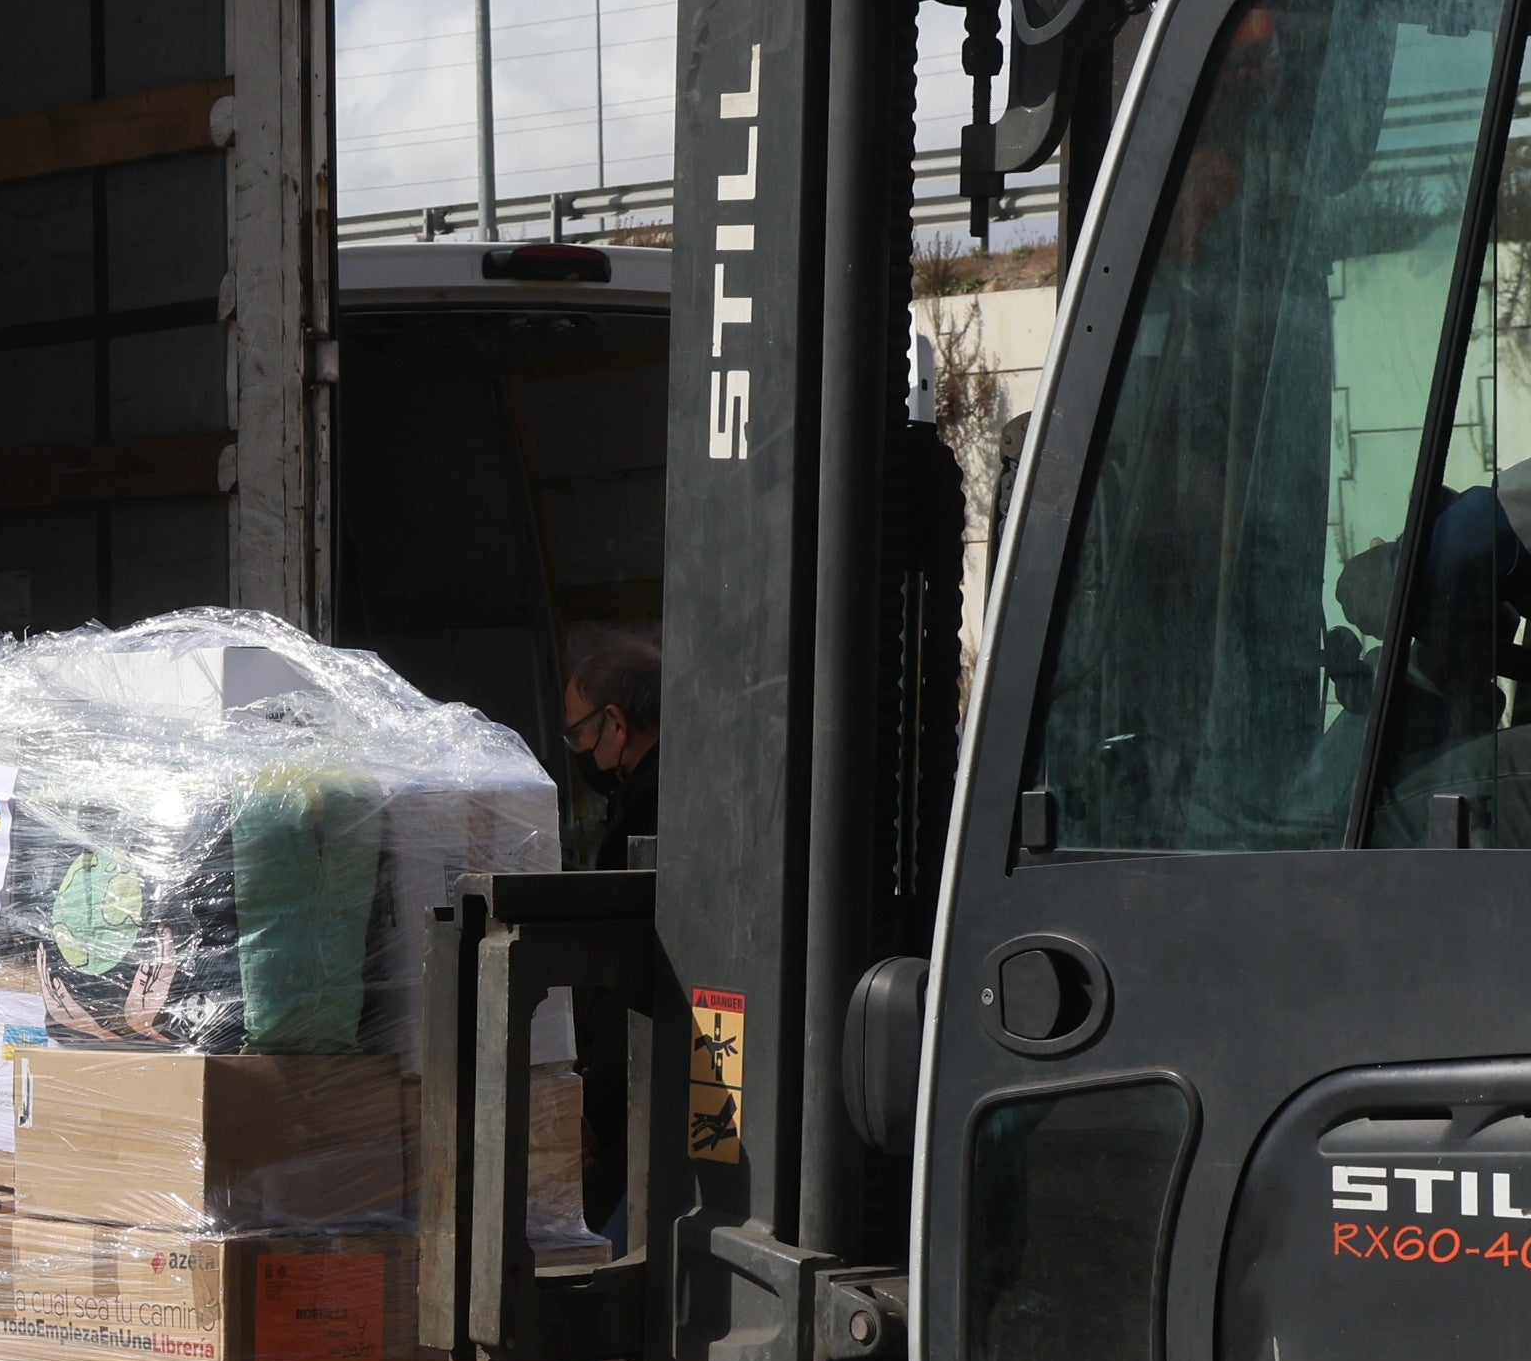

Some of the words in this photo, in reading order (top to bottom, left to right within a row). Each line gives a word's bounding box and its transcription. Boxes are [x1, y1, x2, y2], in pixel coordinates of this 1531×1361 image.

[709, 43, 760, 459] STILL
[710, 995, 743, 1009] DANGER
[169, 1252, 215, 1271] azeta
[31, 1289, 69, 1317] cual
[74, 1296, 109, 1320] sea
[115, 1299, 133, 1324] tu
[138, 1301, 216, 1332] camino
